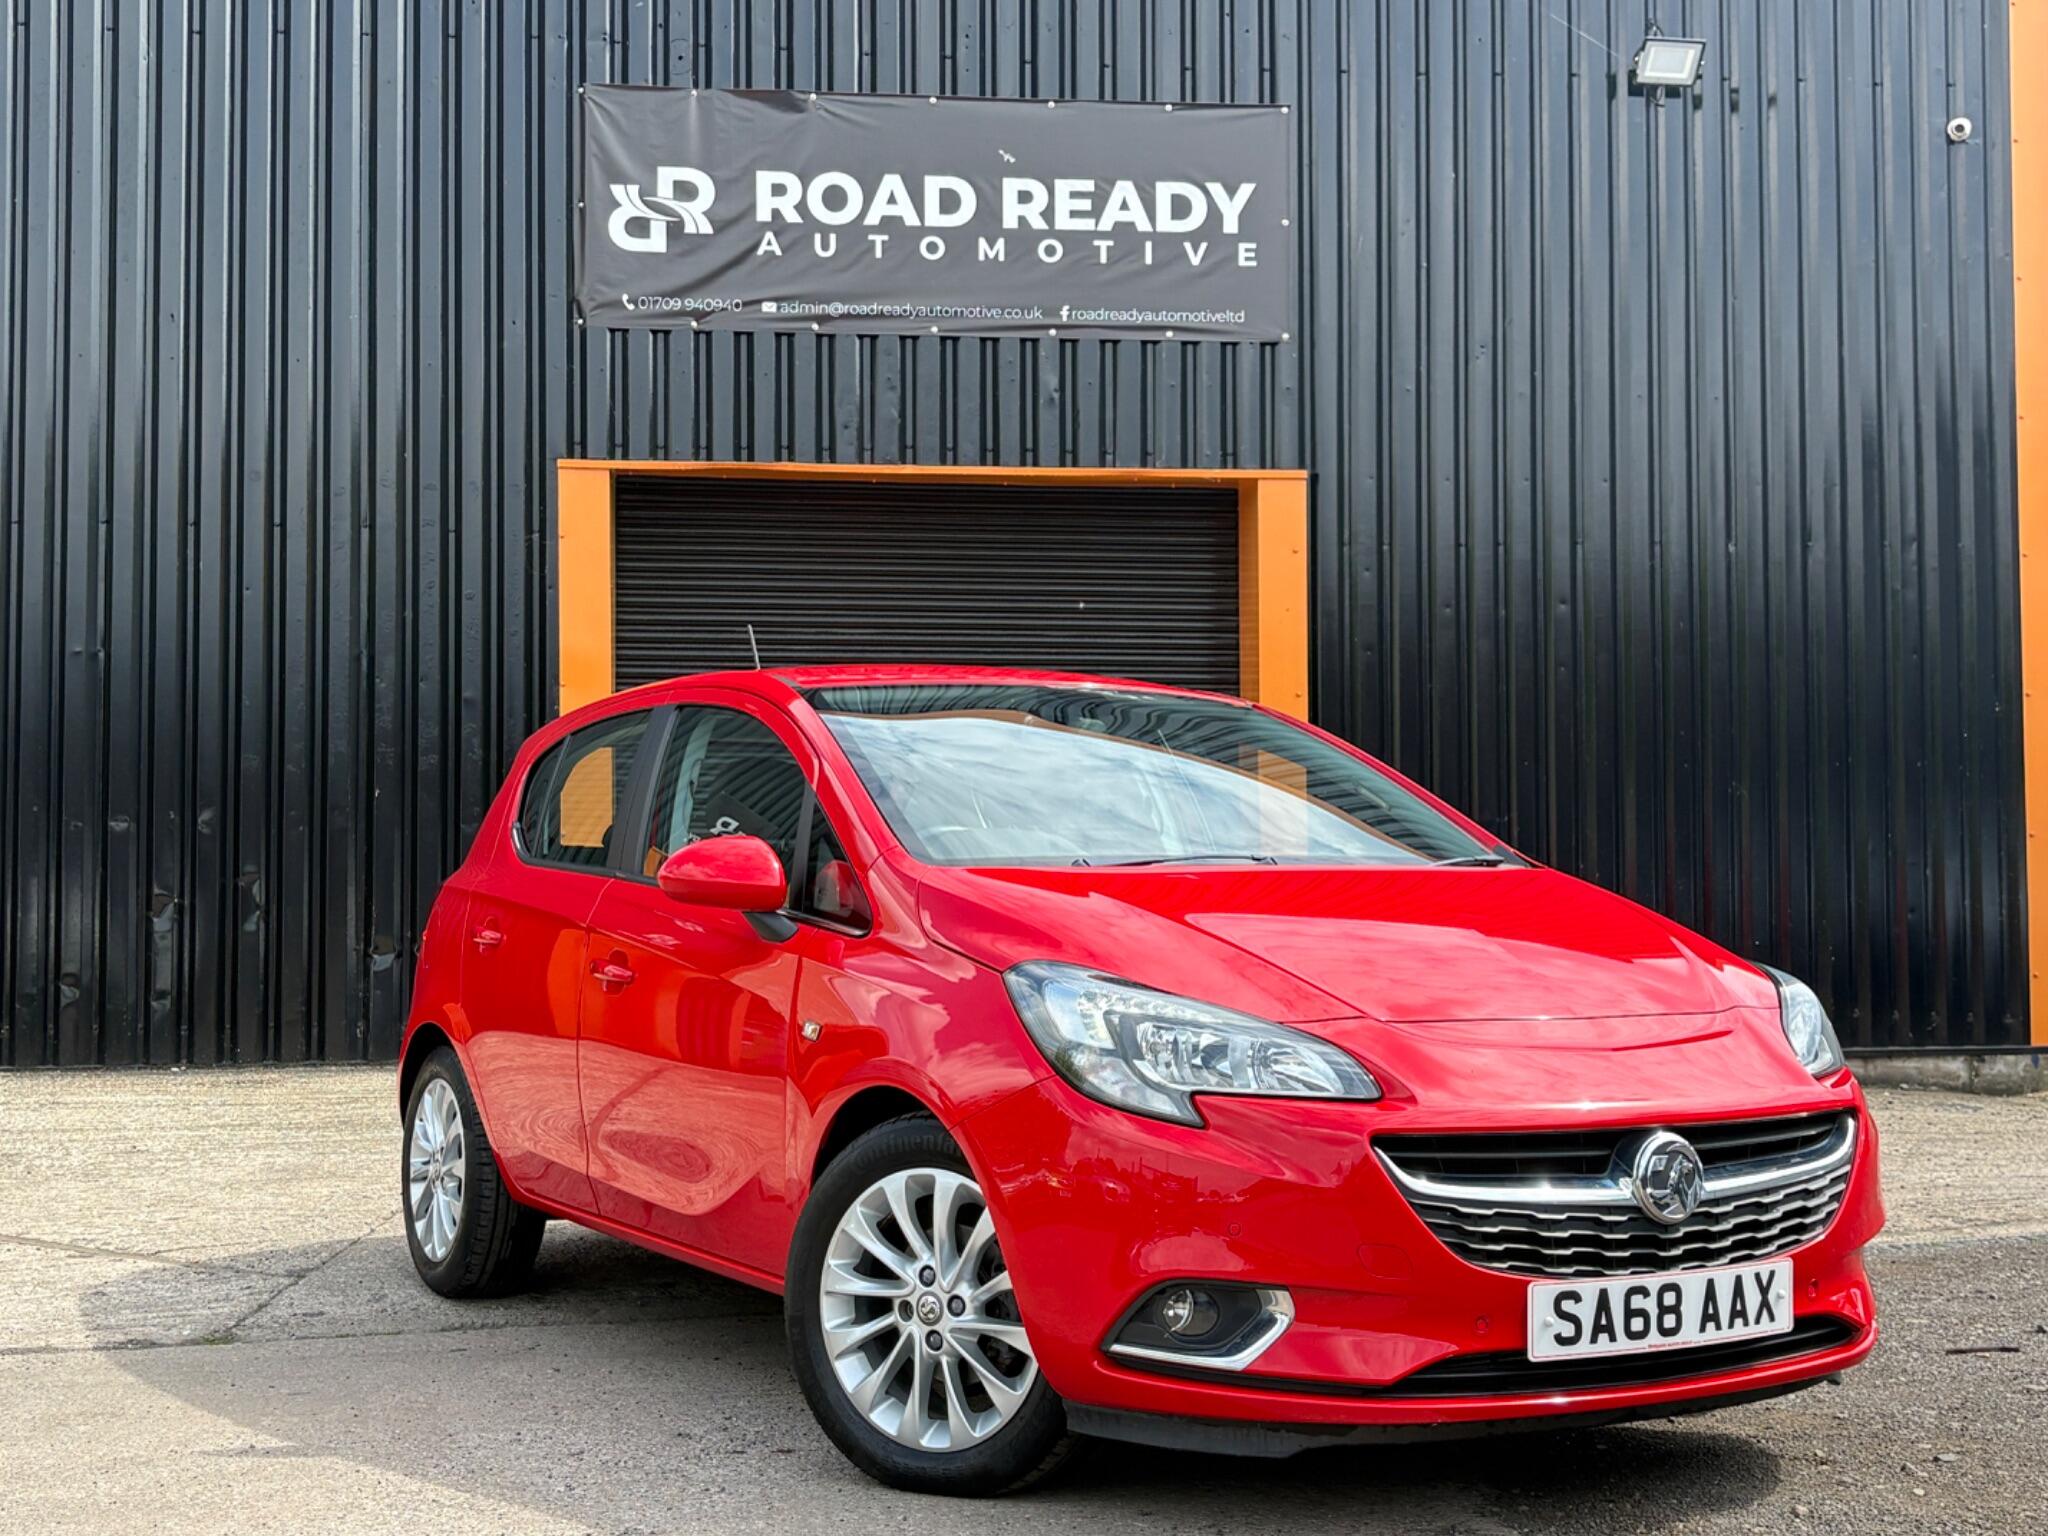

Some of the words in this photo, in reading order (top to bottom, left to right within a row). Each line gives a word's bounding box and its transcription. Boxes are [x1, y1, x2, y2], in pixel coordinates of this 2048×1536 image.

[755, 169, 978, 228] ROAD
[1001, 176, 1257, 235] READY
[756, 230, 1258, 267] AUTOMOTIVE
[637, 296, 682, 312] 01709
[684, 297, 743, 313] 940940
[779, 301, 1044, 320] admin@roadreadyautomotive.co.uk
[1071, 308, 1246, 324] roadreadyautomotiveltd
[1553, 1282, 1684, 1347] SA68
[1699, 1270, 1776, 1334] AAX
